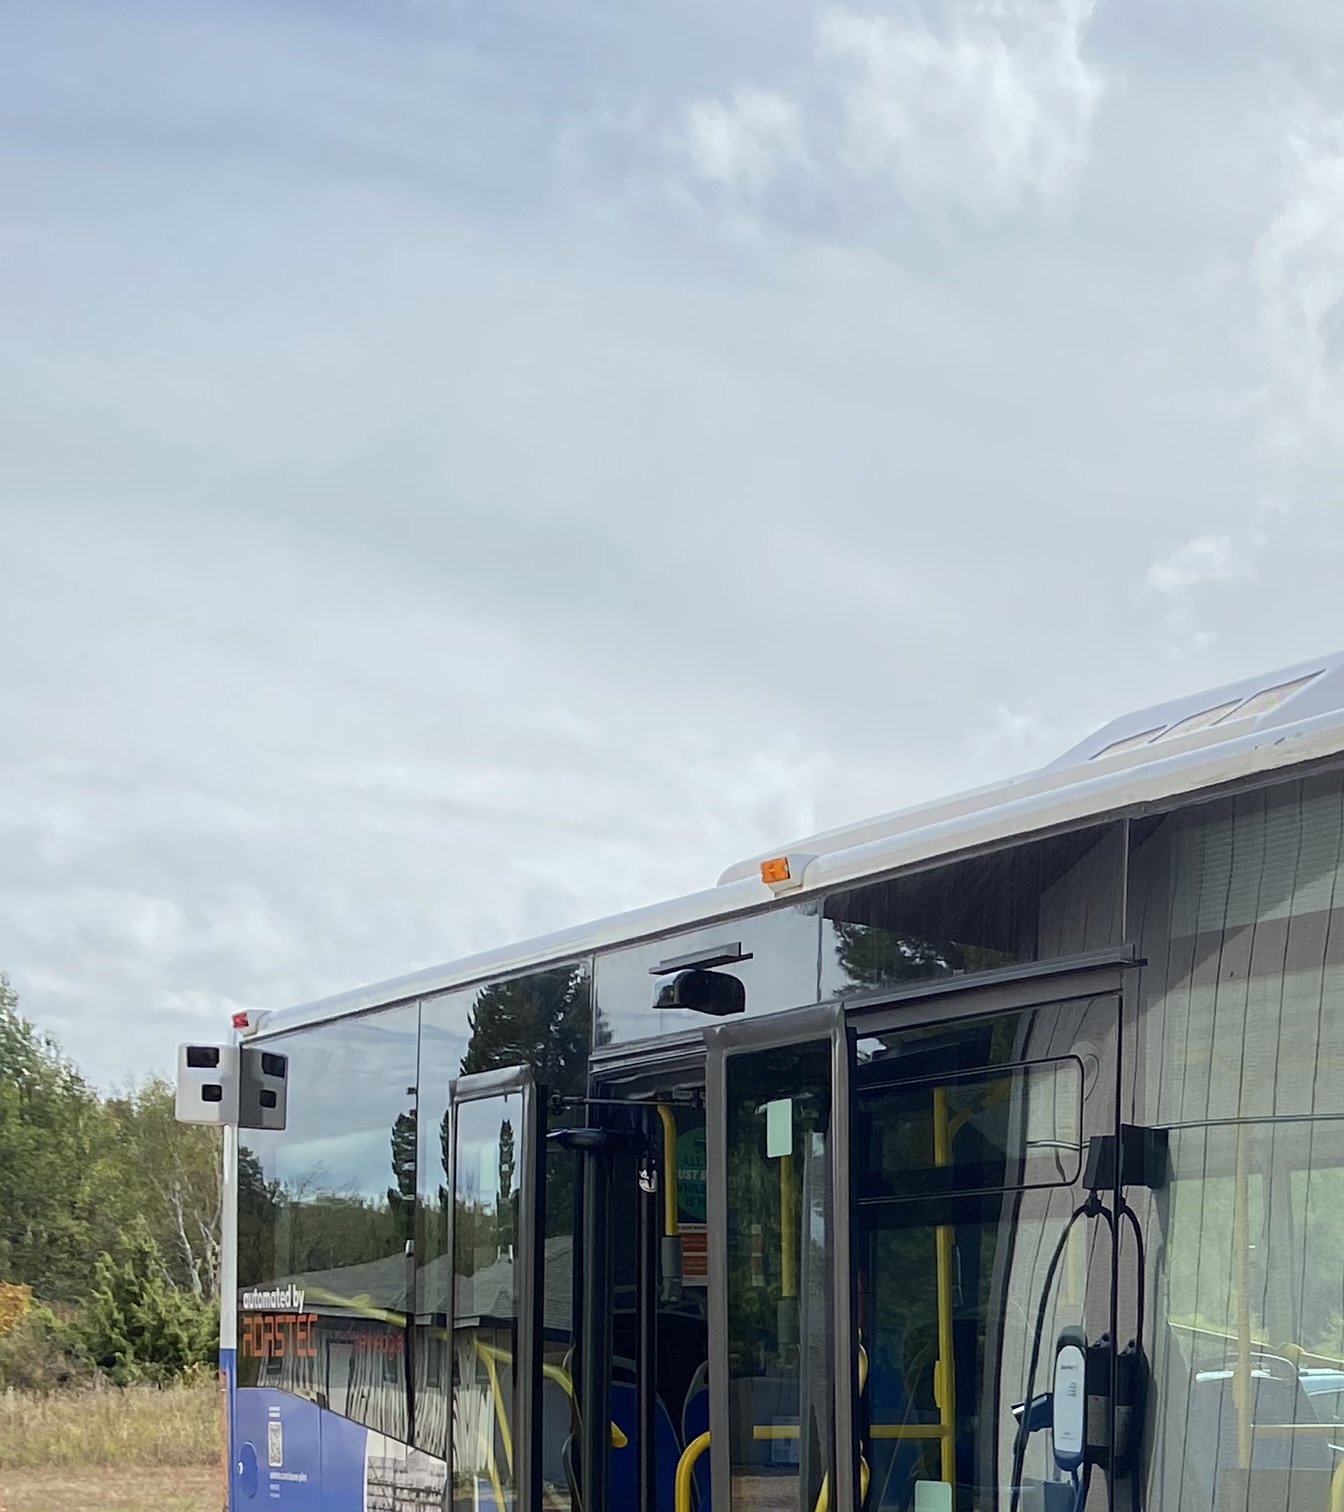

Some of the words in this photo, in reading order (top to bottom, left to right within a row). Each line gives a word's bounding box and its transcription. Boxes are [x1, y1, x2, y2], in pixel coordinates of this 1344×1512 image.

[677, 1169, 699, 1180] UST
[243, 1284, 292, 1309] automated
[293, 1284, 305, 1314] by
[243, 1313, 318, 1357] ADASTEC
